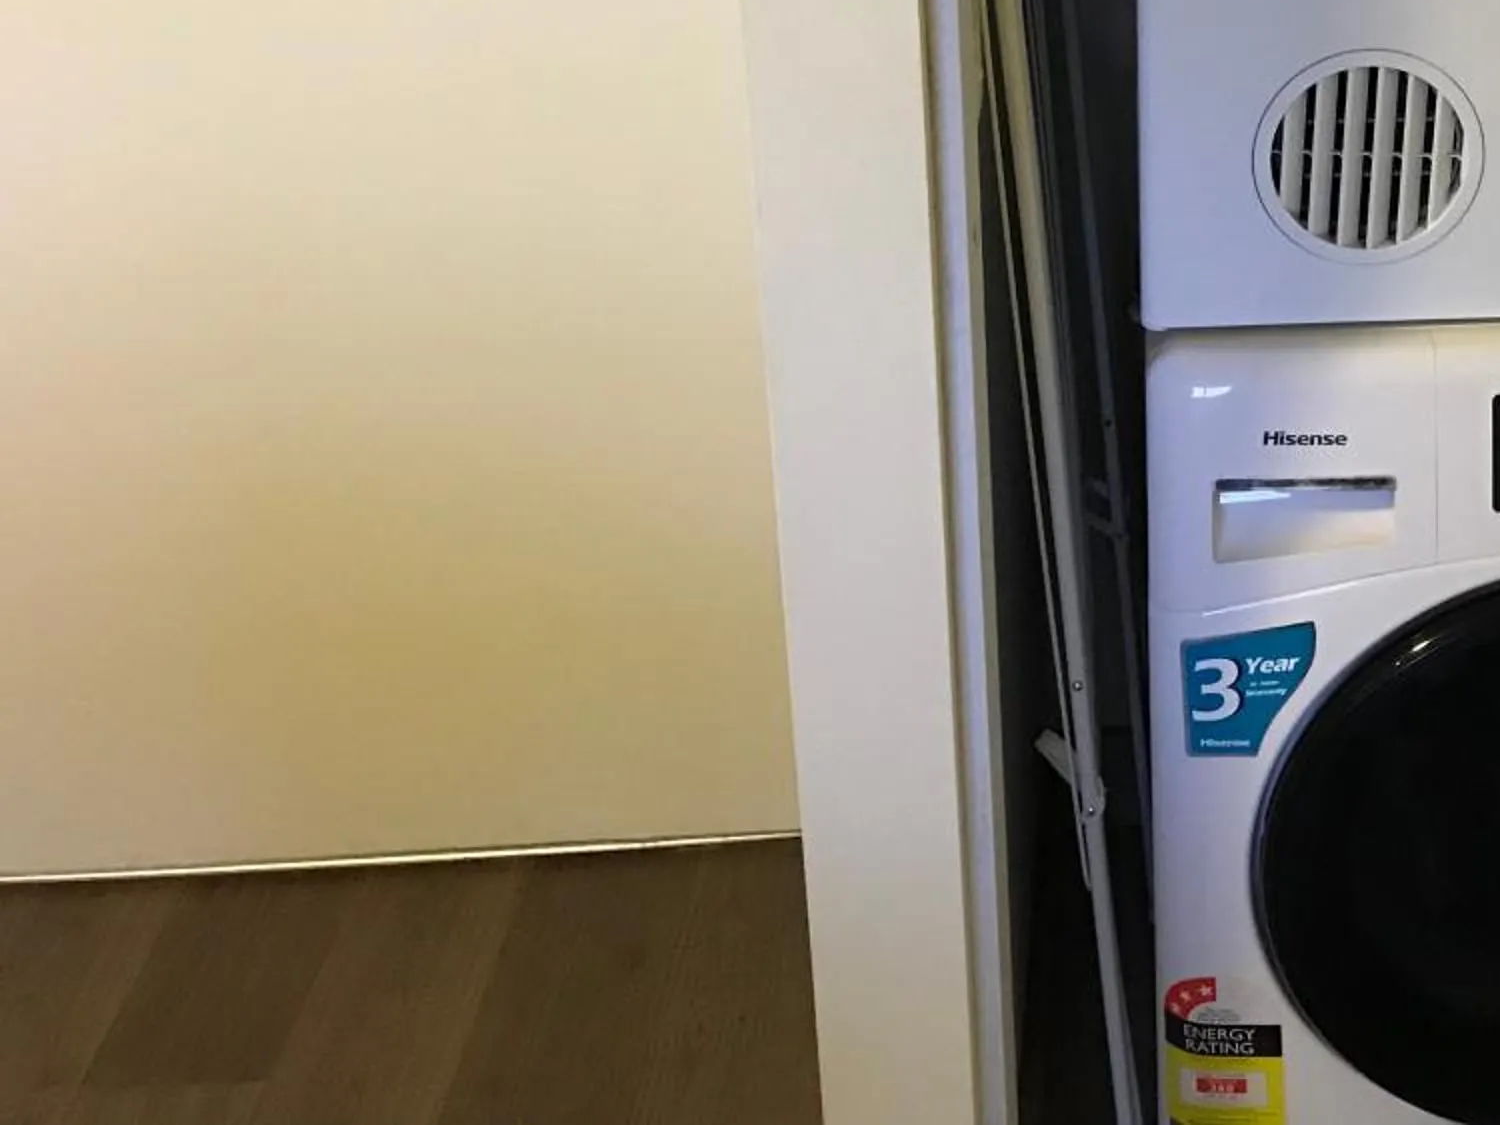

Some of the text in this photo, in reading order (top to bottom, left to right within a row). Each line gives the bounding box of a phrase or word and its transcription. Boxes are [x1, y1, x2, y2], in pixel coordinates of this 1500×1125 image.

[1263, 430, 1348, 446] Hisense
[1192, 657, 1301, 722] 3 Year
[1183, 1024, 1256, 1041] ENERGY
[1185, 1039, 1255, 1054] RATING
